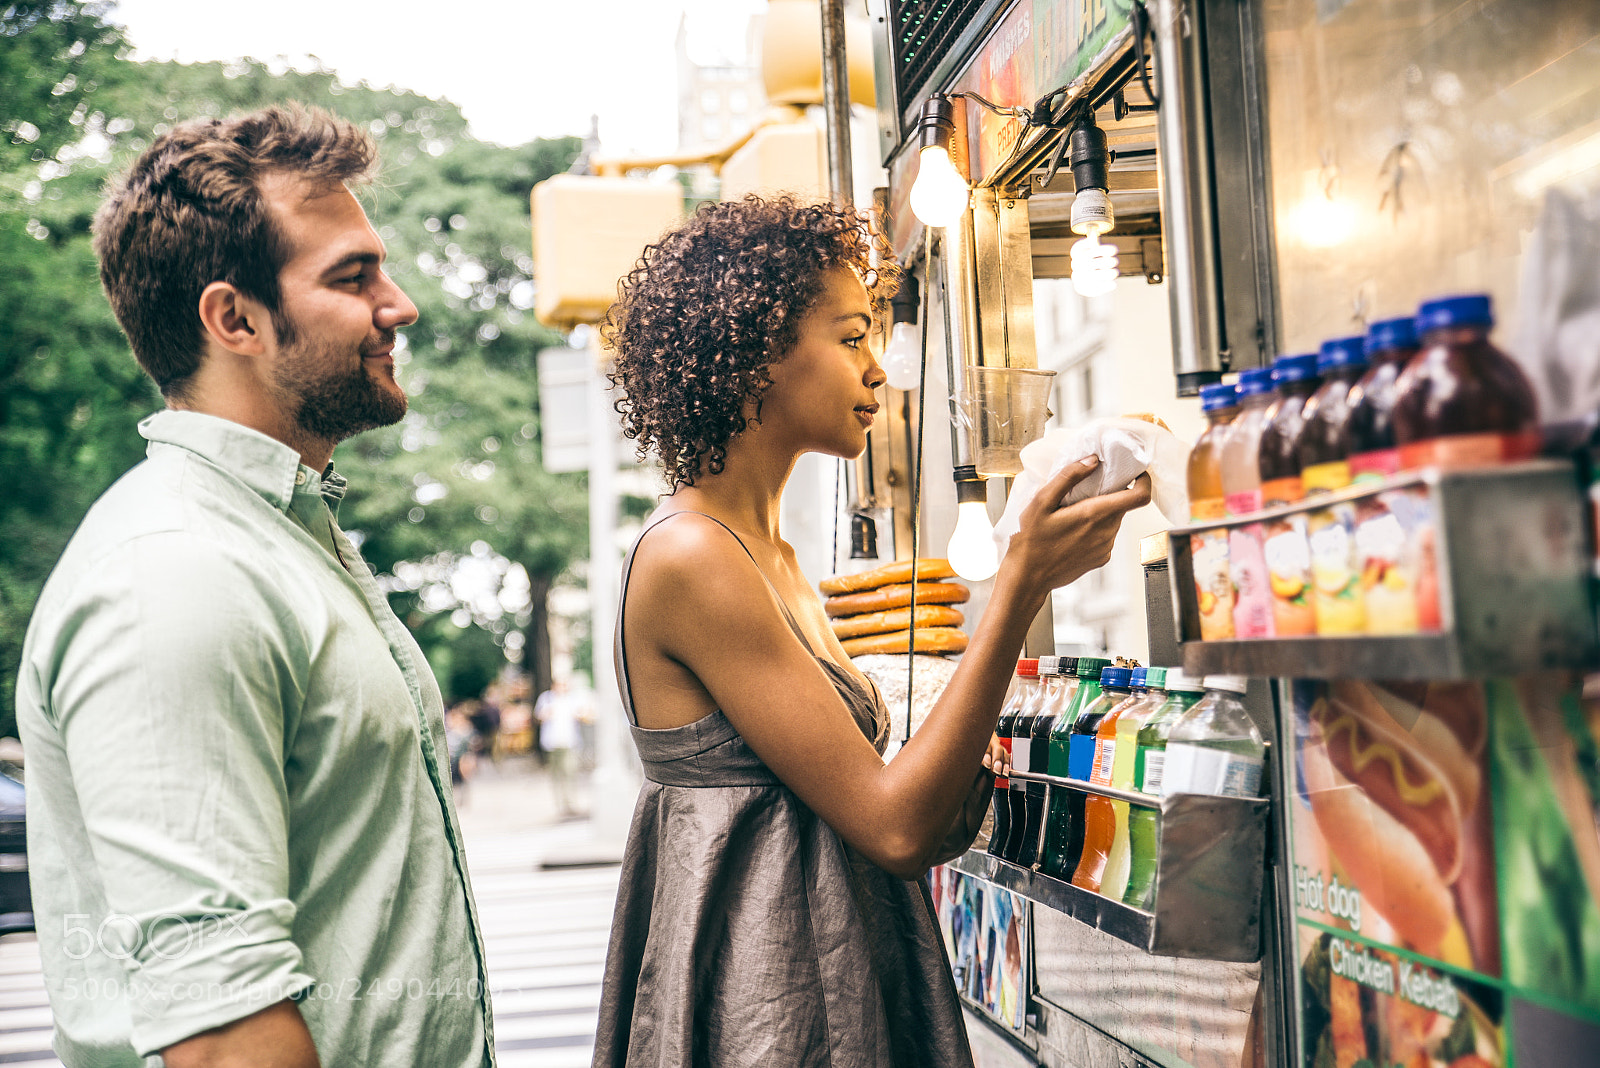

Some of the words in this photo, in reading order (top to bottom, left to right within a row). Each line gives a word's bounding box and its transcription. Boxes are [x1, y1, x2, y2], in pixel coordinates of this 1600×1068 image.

[989, 10, 1030, 80] KNISHES
[1295, 865, 1325, 911] Hot
[1328, 876, 1361, 931] dog
[1330, 938, 1394, 995] Chicken
[1400, 959, 1460, 1018] Kebab
